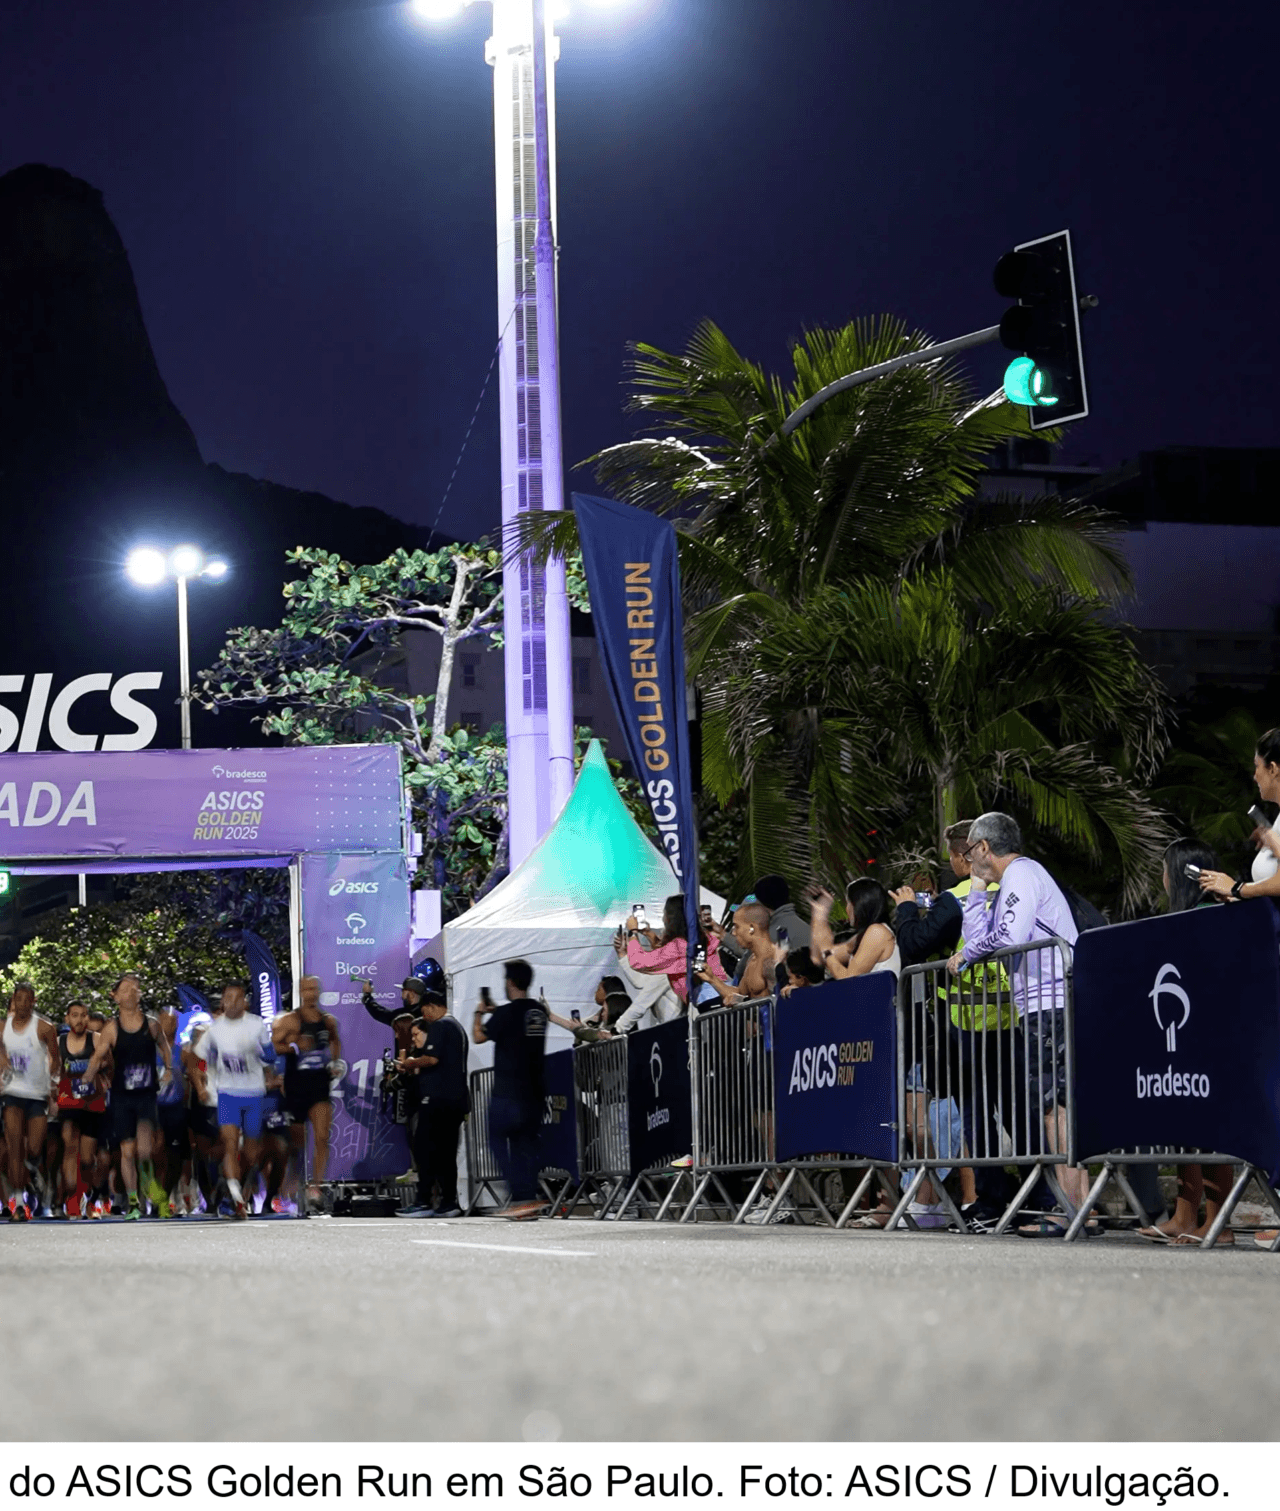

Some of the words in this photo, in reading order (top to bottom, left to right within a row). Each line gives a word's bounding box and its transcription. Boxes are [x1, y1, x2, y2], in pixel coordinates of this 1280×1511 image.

[624, 562, 655, 630] RUN
[630, 637, 671, 772] GOLDEN
[226, 769, 267, 779] bradesco
[200, 790, 265, 811] ASICS
[197, 811, 263, 826] GOLDEN
[193, 827, 224, 841] RUN
[224, 826, 259, 840] 2025
[345, 880, 379, 894] asics
[336, 936, 375, 946] bradesco
[335, 961, 378, 975] Bioré
[838, 1040, 874, 1063] GOLDEN
[788, 1043, 838, 1096] ASICS
[837, 1066, 855, 1086] RUN
[1136, 1063, 1211, 1099] bradesco
[647, 1105, 670, 1131] bradesco
